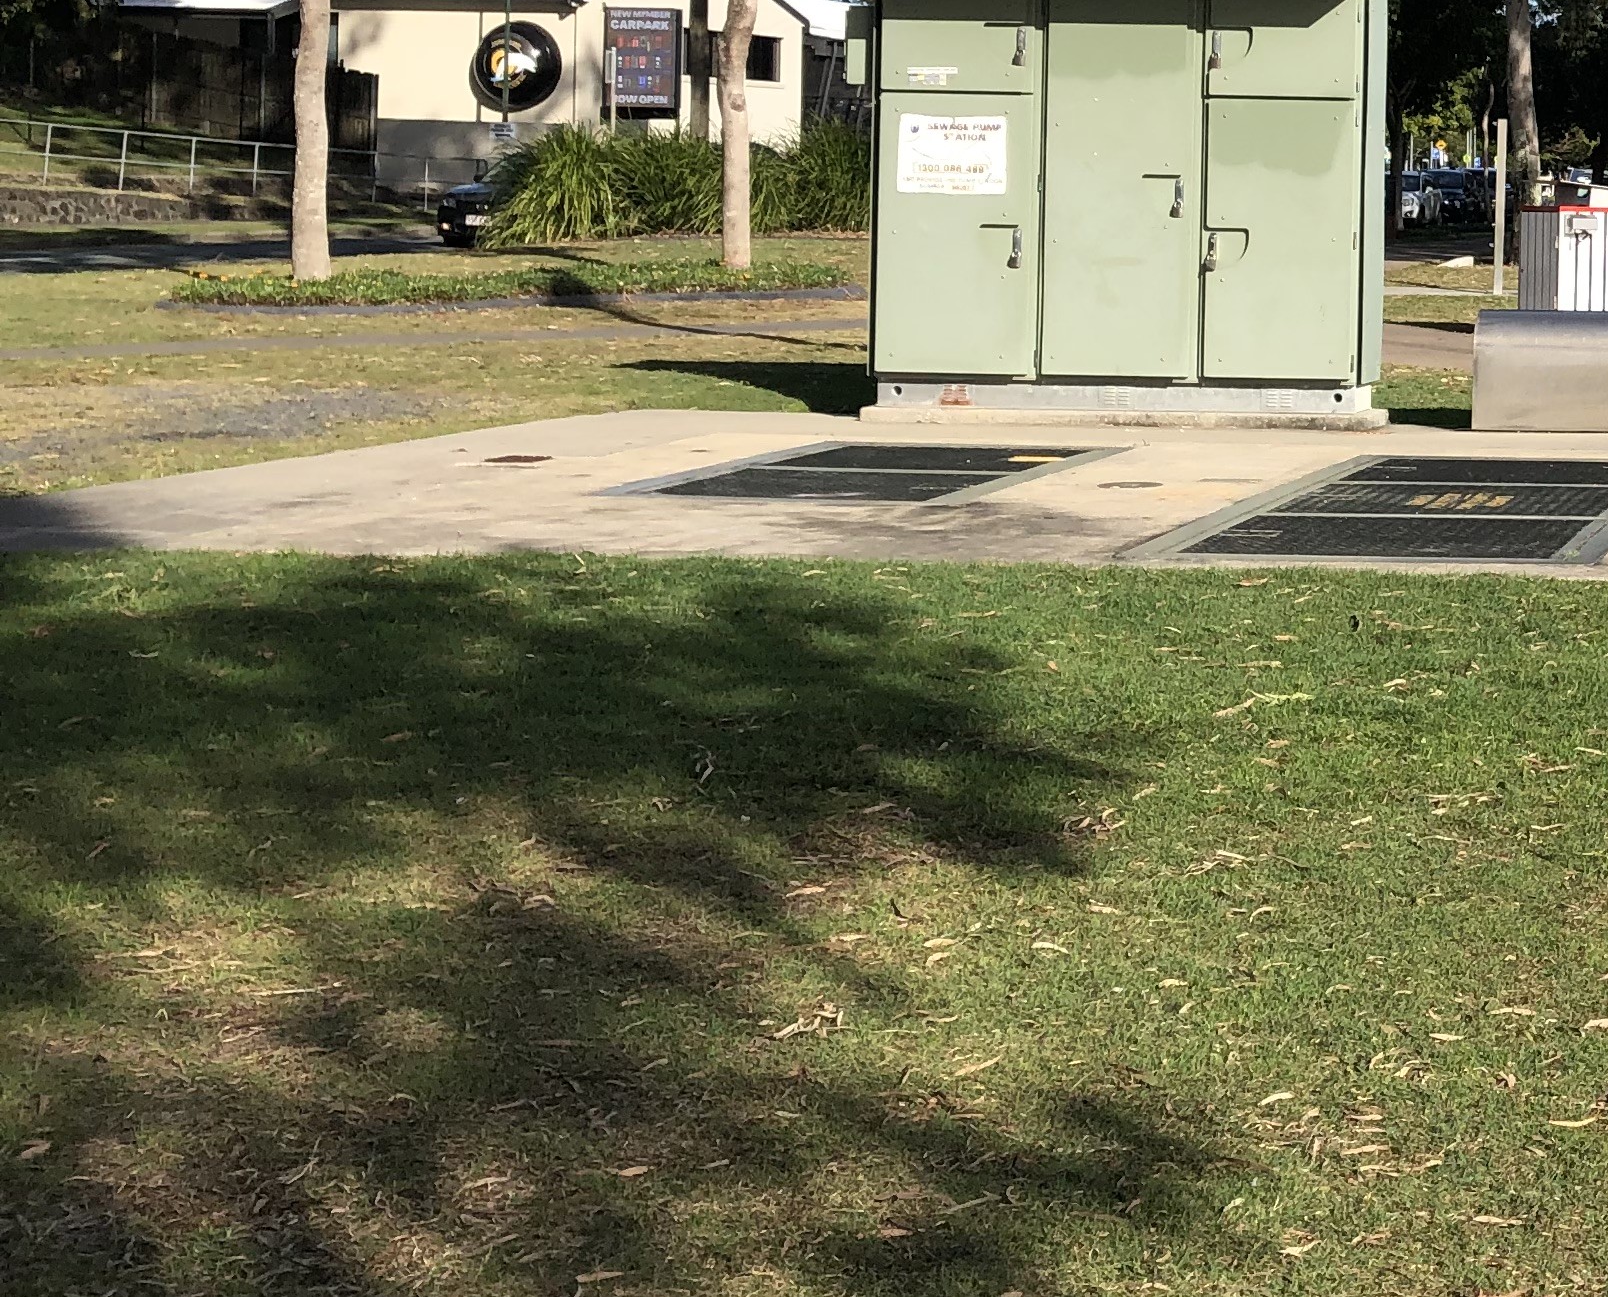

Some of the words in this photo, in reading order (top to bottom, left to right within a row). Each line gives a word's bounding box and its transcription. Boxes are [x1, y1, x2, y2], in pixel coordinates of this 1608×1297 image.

[610, 9, 632, 18] NEW
[610, 19, 670, 31] CARPARK
[638, 94, 668, 105] OPEN
[927, 123, 969, 131] SEWAGE
[973, 123, 1002, 132] PUMP
